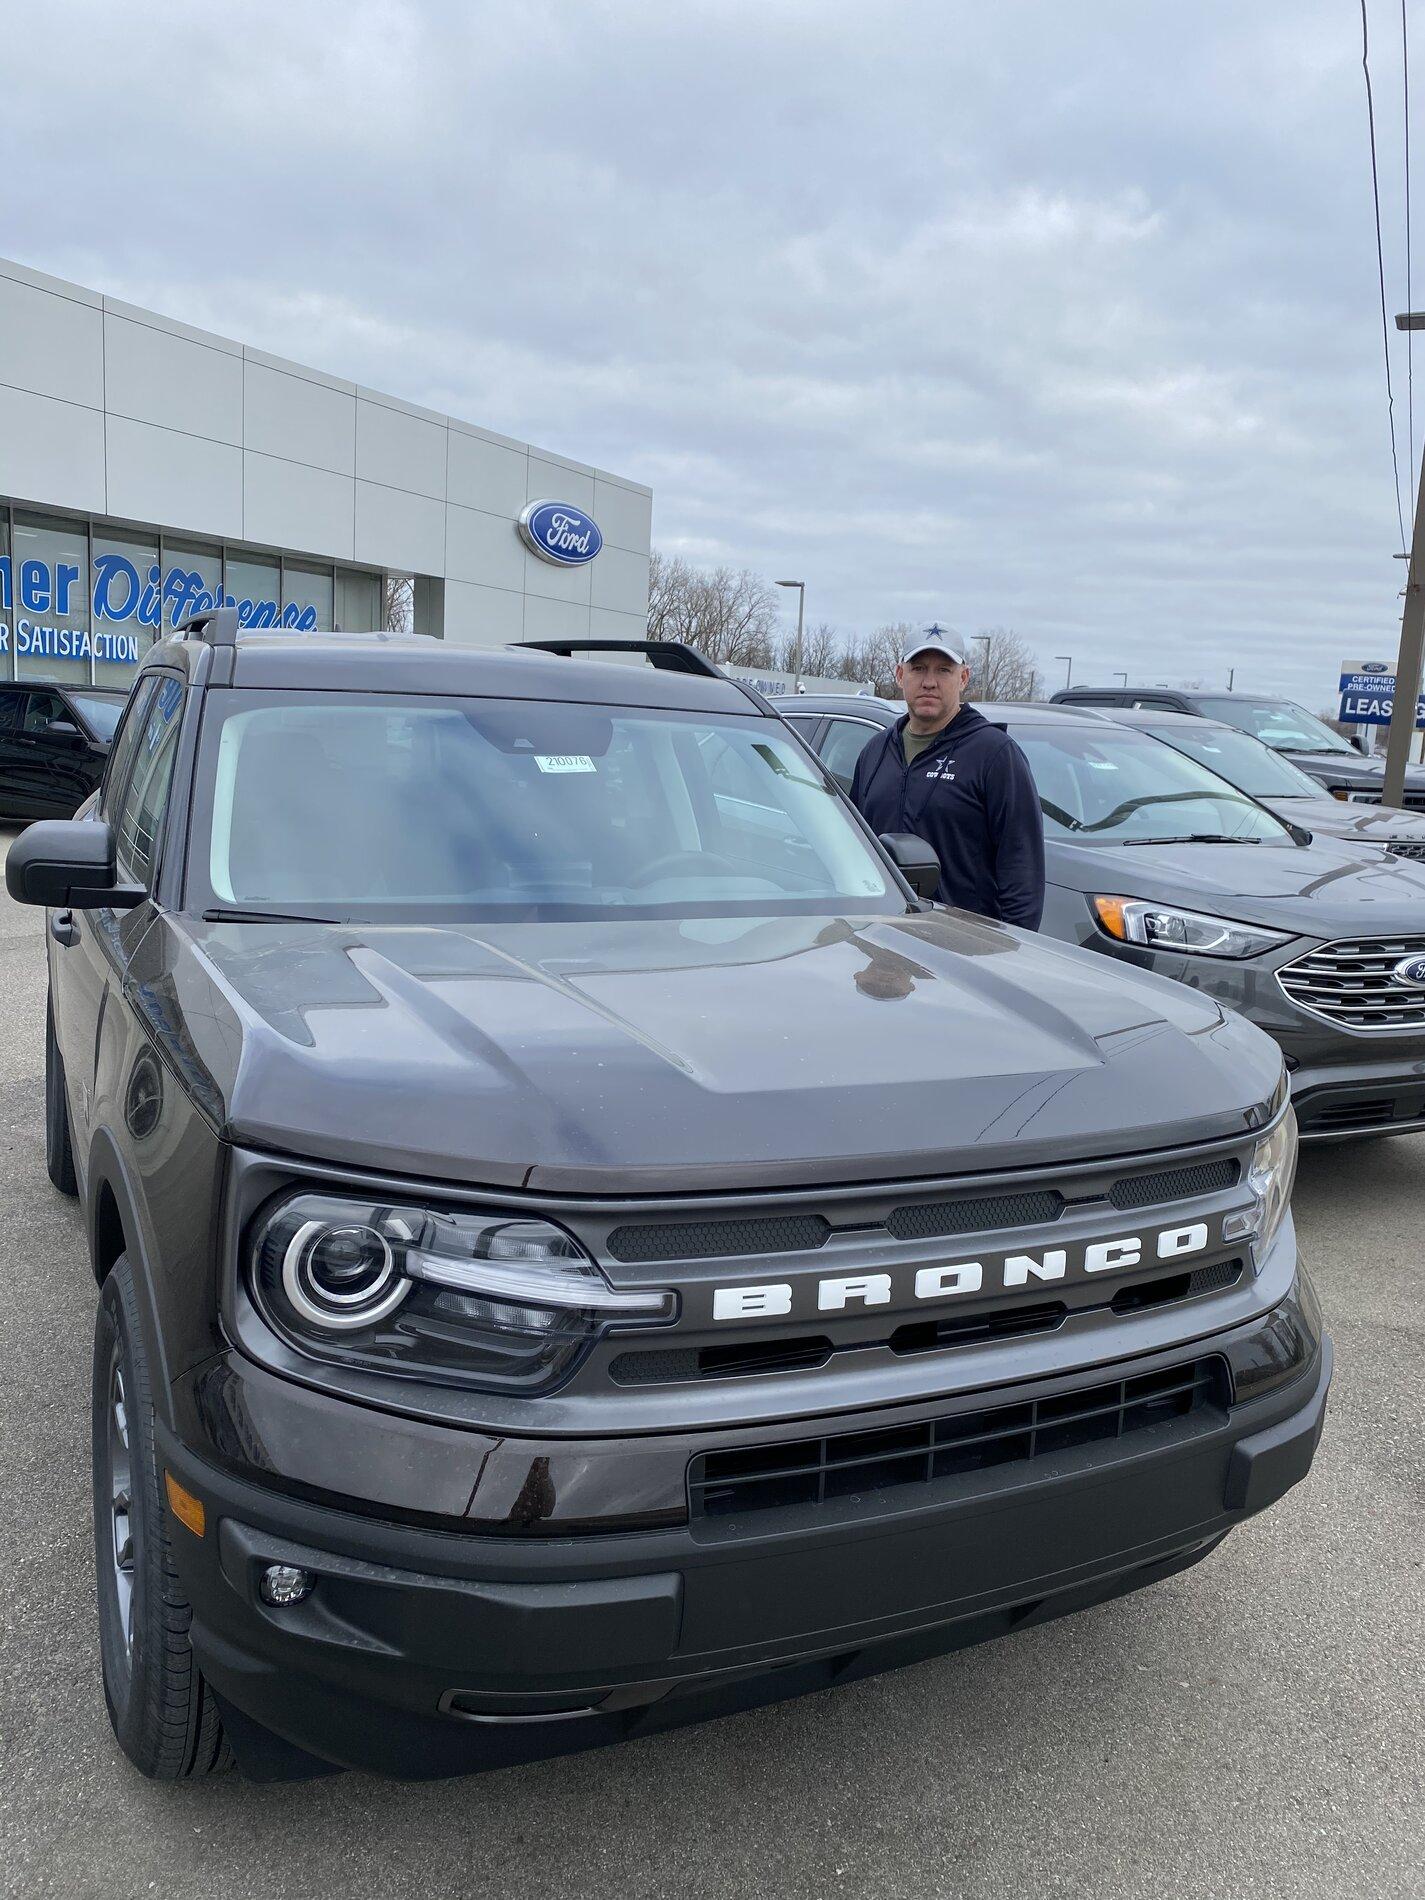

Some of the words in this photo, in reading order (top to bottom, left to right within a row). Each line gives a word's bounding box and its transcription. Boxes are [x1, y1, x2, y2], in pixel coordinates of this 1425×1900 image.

[547, 513, 590, 553] Ford
[17, 618, 138, 661] SATISFACTION
[1352, 675, 1395, 685] CERTIFIED
[1345, 698, 1425, 719] LEASG
[926, 771, 955, 780] COWOYS
[712, 1223, 1208, 1320] BRONCO
